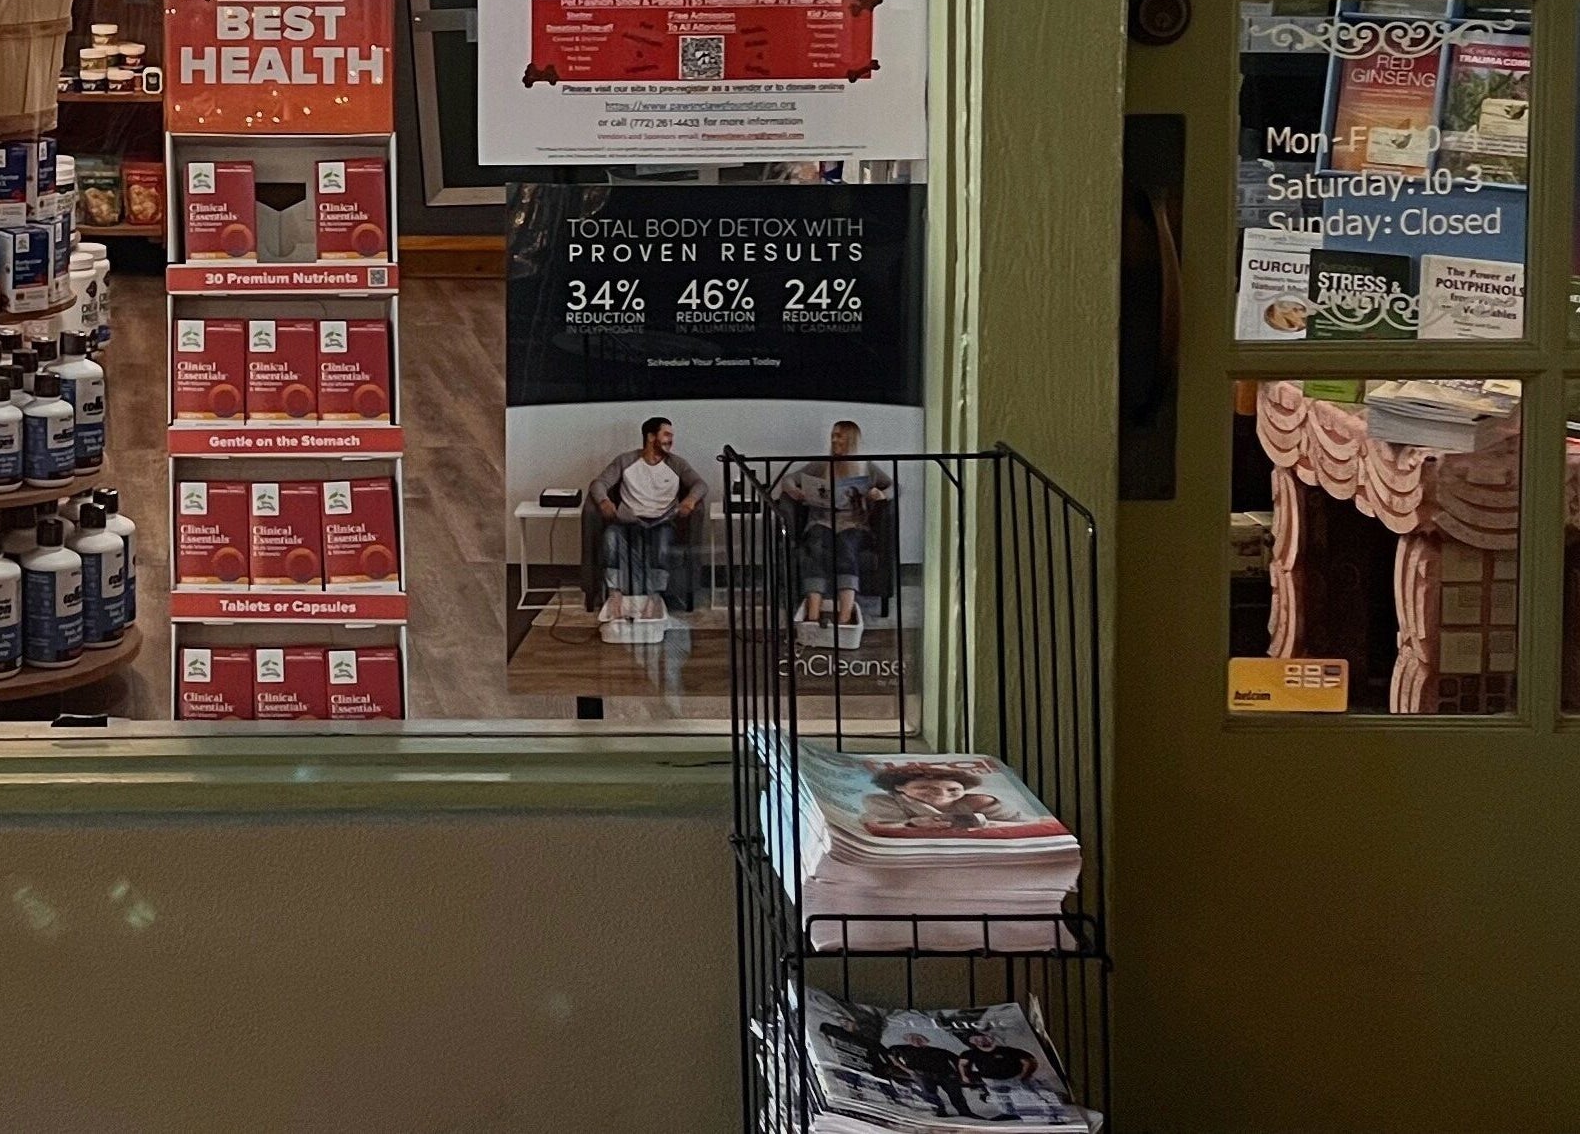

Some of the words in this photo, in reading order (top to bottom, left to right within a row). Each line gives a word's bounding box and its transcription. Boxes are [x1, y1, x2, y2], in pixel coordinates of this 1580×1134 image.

[217, 6, 346, 40] BEST
[180, 47, 383, 84] HEALTH
[1376, 55, 1414, 70] RED
[1351, 67, 1436, 88] GINSENG
[1268, 169, 1415, 202] Saturday:
[189, 203, 227, 212] Clinical
[189, 212, 238, 221] Essentials
[567, 219, 638, 239] TOTAL
[646, 219, 712, 238] BODY
[719, 218, 797, 238] DETOX
[804, 218, 863, 237] WITH
[1269, 208, 1392, 242] Sunday:
[1400, 207, 1501, 236] Closed
[569, 244, 697, 263] PROVEN
[721, 243, 863, 262] RESULTS
[205, 273, 224, 285] 30
[227, 273, 289, 284] Premium
[293, 272, 358, 284] Nutrients
[1447, 267, 1466, 276] The
[1318, 272, 1387, 292] STRESS
[1436, 278, 1525, 297] POLYPHENOLS
[566, 280, 645, 311] 34%
[677, 278, 755, 310] 46%
[785, 278, 862, 310] 24%
[566, 312, 645, 323] REDUCTION
[676, 311, 755, 323] REDUCTION
[783, 311, 863, 322] REDUCTION
[209, 436, 253, 447] Gentle
[256, 438, 272, 447] on
[276, 436, 298, 447] the
[301, 435, 360, 447] Stomach
[220, 599, 271, 612] Tablets
[274, 602, 289, 612] or
[292, 601, 356, 614] Capsules
